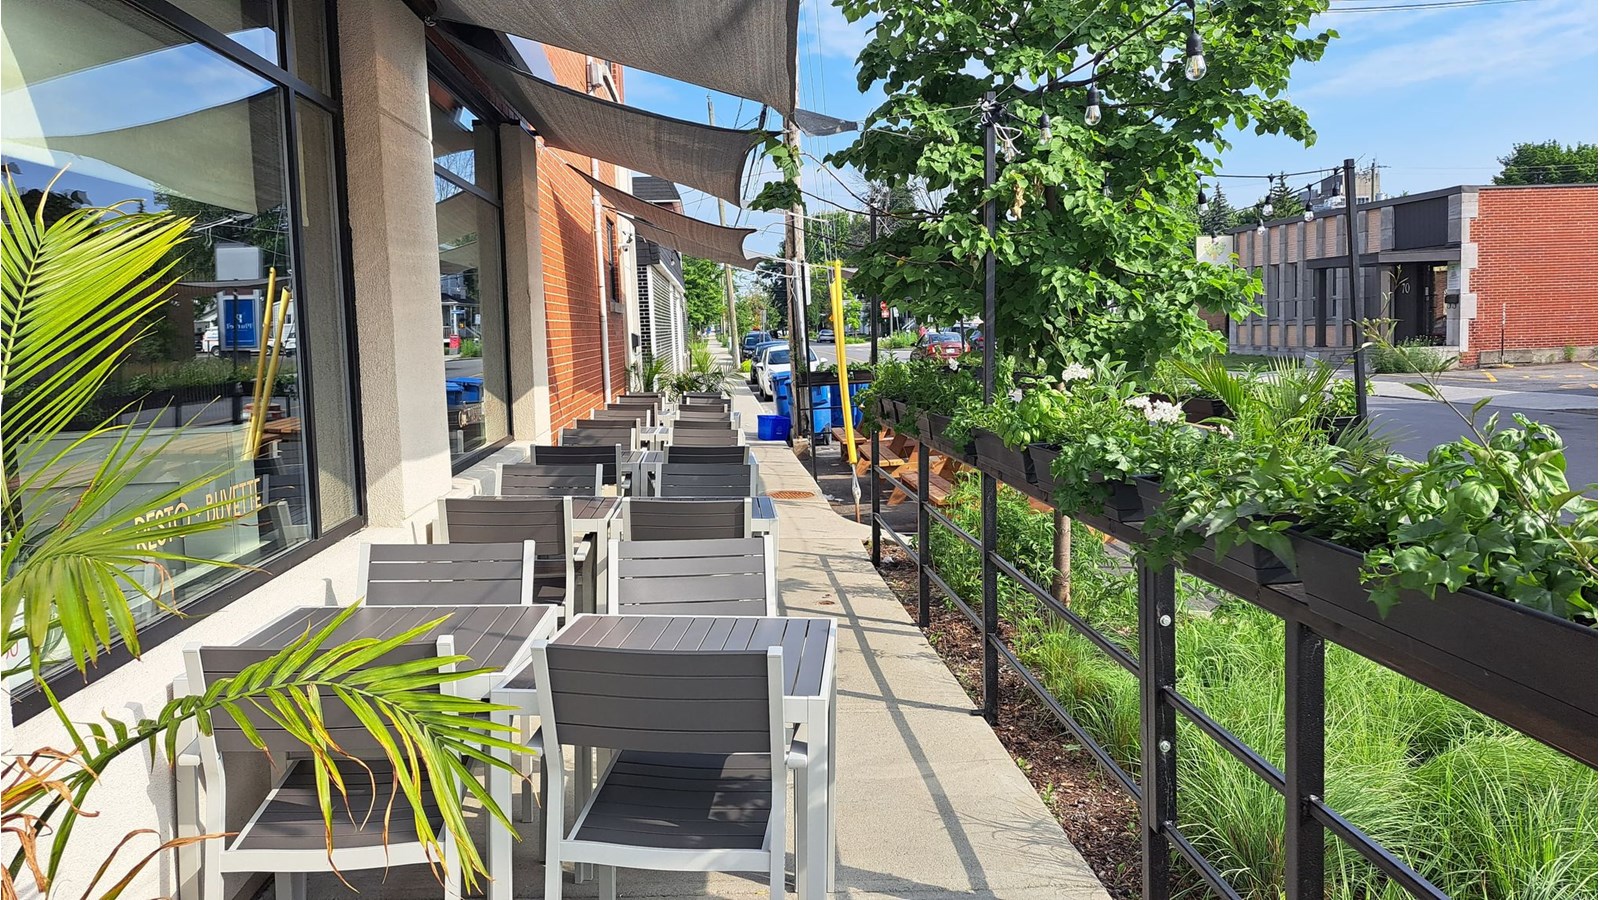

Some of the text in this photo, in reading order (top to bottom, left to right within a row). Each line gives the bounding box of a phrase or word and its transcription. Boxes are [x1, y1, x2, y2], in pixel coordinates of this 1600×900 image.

[1401, 282, 1411, 294] 70
[134, 502, 191, 551] RESTO
[206, 478, 262, 522] BUVETTE
